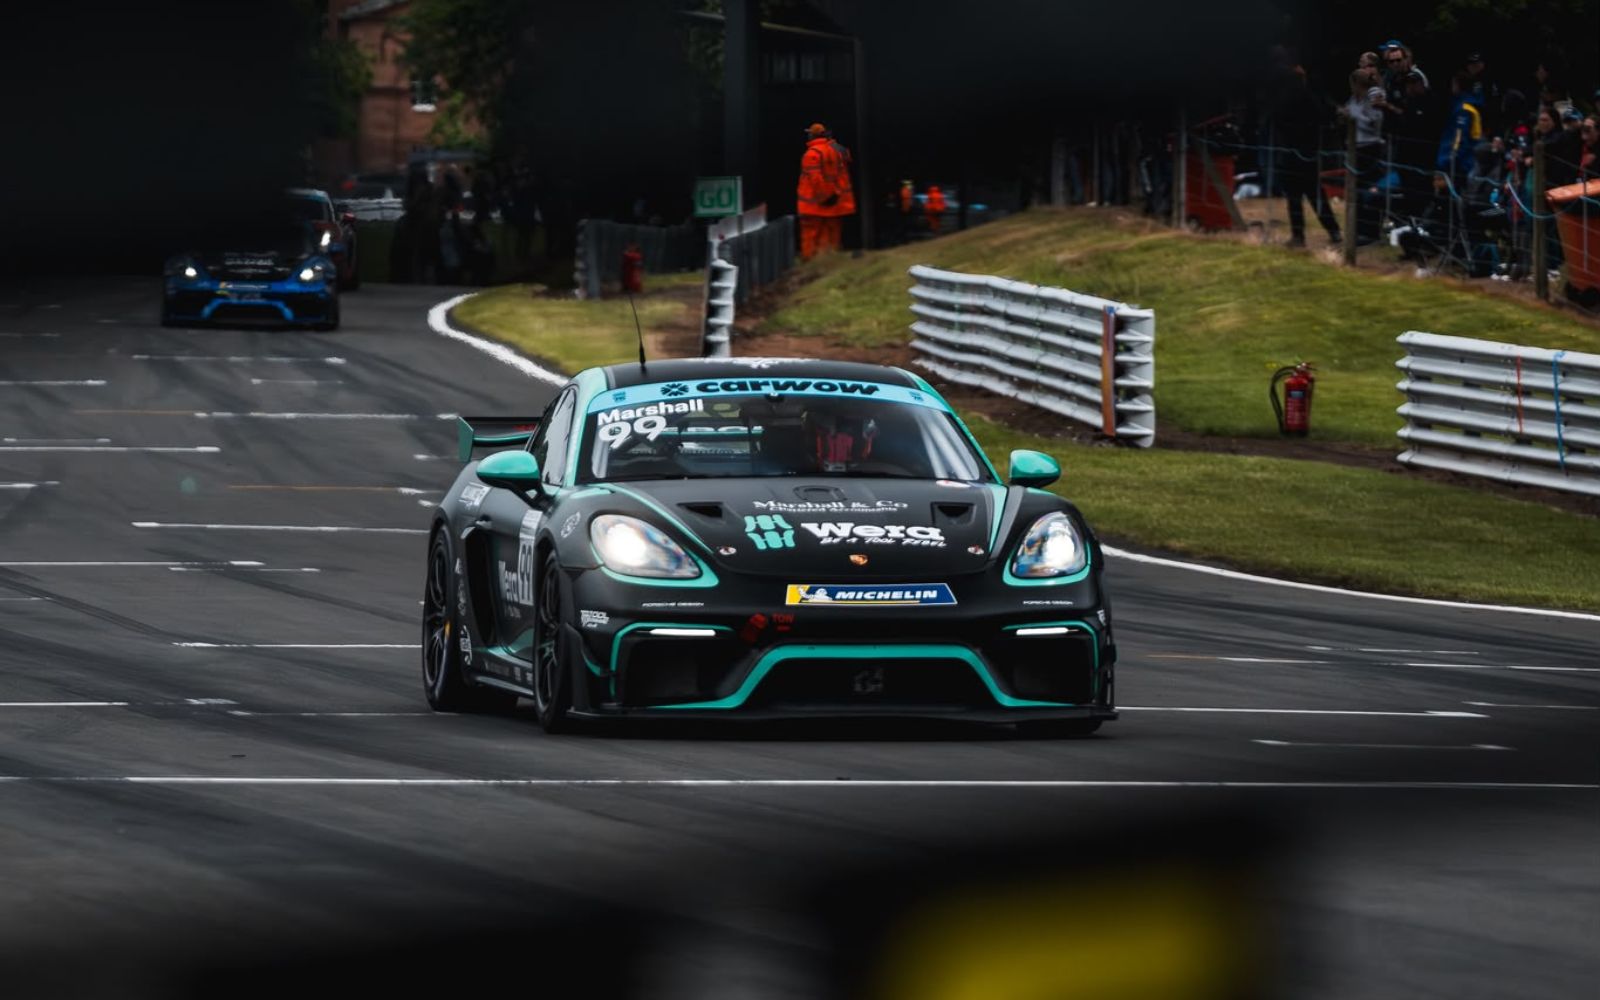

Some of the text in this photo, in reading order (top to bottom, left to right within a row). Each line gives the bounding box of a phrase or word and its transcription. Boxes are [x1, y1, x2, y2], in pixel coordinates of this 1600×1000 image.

[700, 187, 732, 208] GO
[696, 378, 879, 396] carwow
[597, 398, 704, 426] Marshall
[599, 415, 667, 450] 99
[753, 500, 846, 509] Marshall
[876, 500, 908, 509] Co
[800, 522, 946, 541] Wera
[835, 589, 938, 600] MICHELIN
[772, 612, 795, 623] TOW
